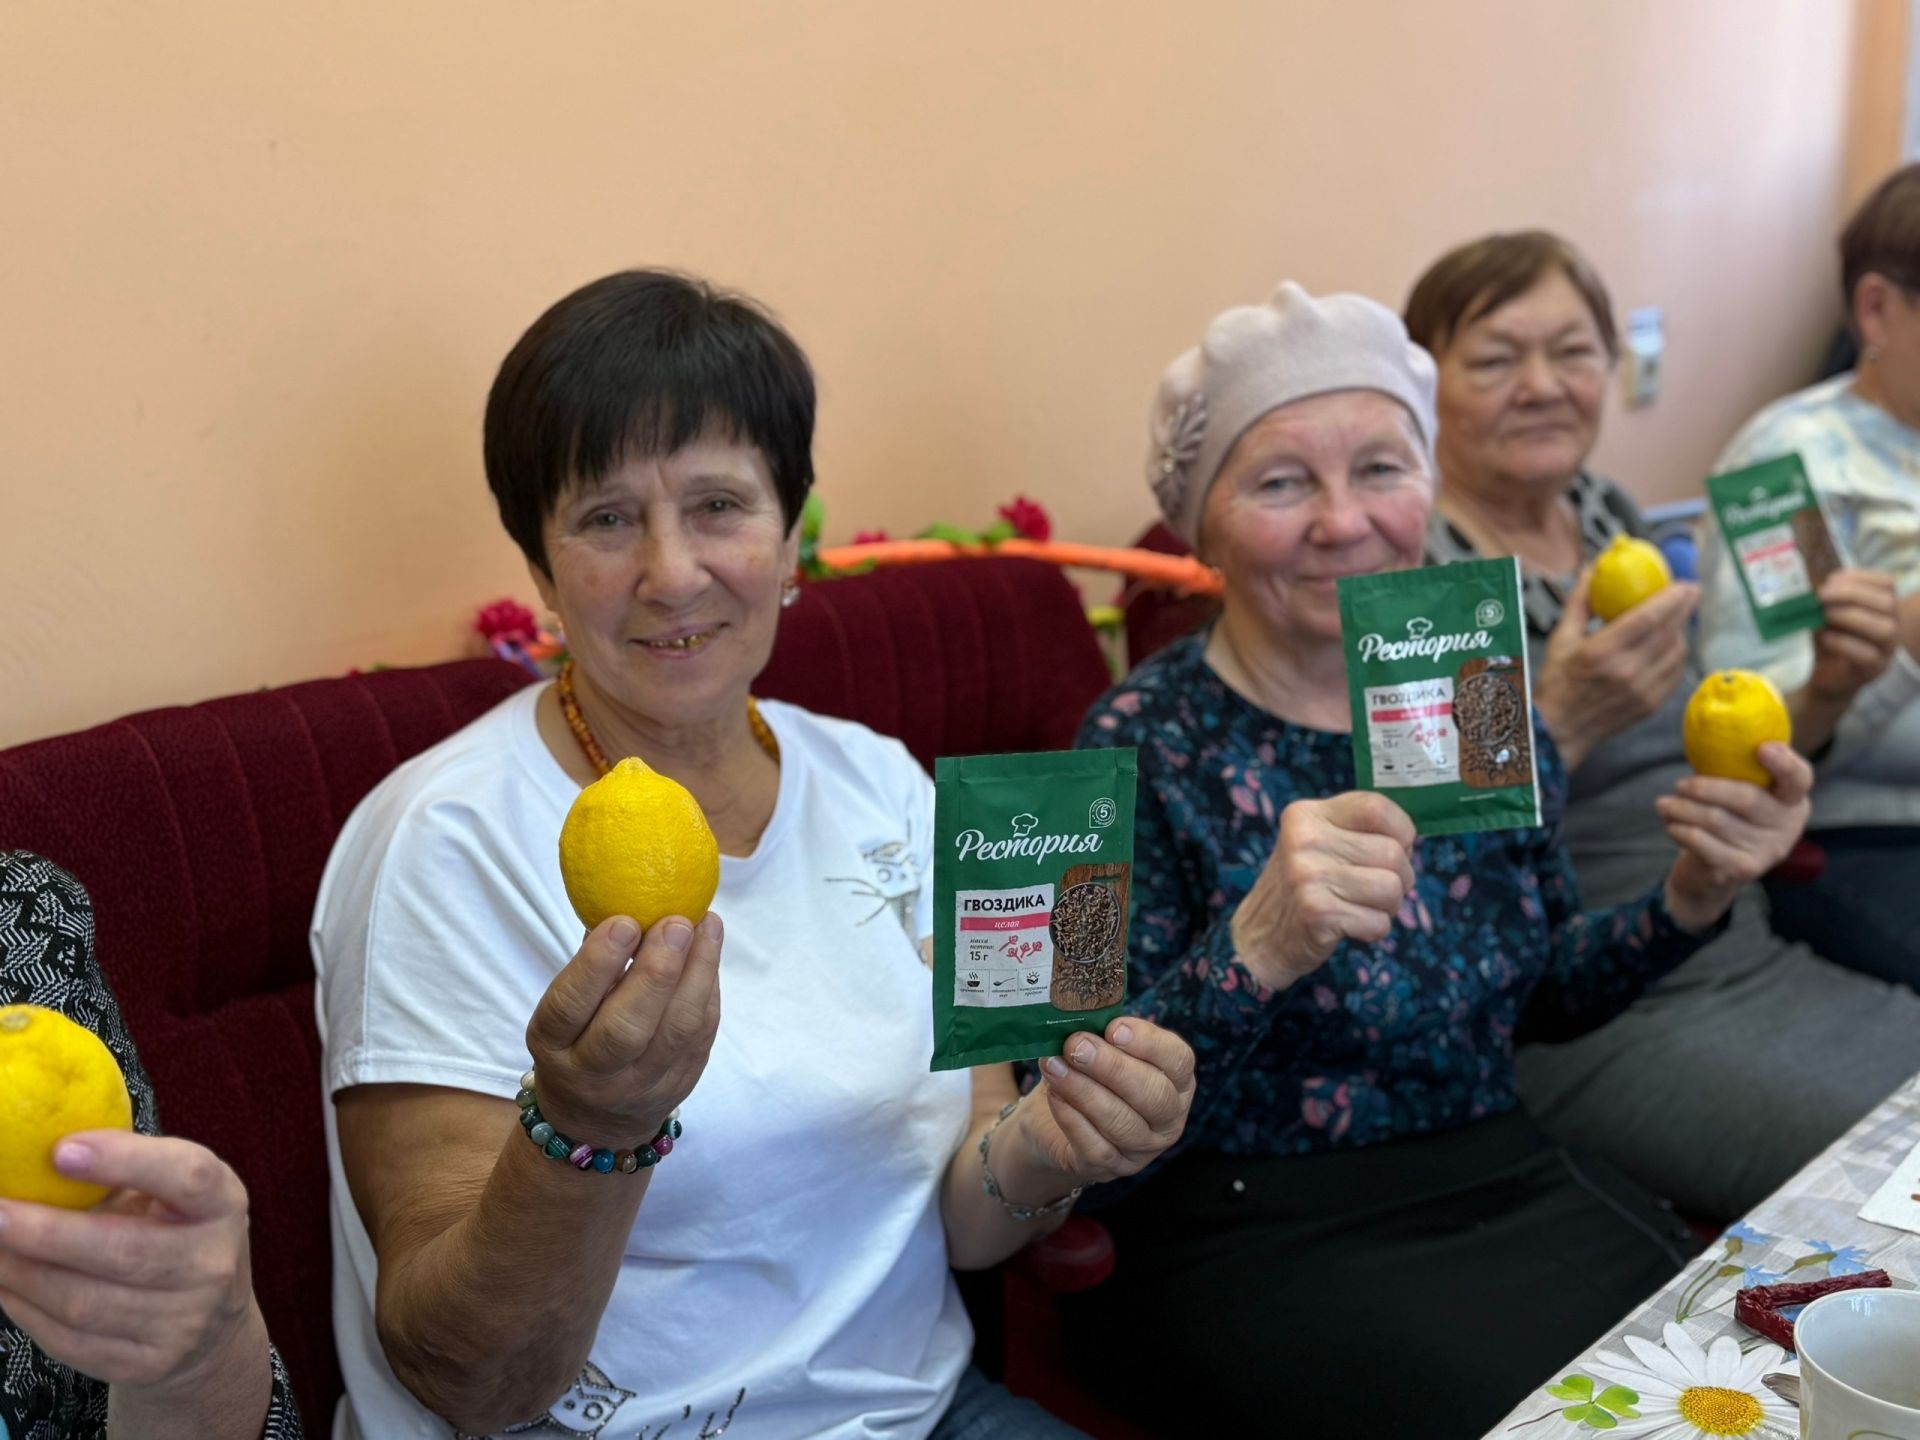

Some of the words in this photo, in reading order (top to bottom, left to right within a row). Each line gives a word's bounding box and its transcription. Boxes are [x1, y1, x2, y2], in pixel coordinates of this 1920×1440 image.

[1358, 630, 1493, 663] Рестория
[1372, 687, 1446, 705] ГВОИКА
[1100, 804, 1108, 818] 5
[955, 829, 1103, 865] Рестория
[963, 894, 1046, 912] ГВОЗДИКА
[969, 951, 981, 961] 15
